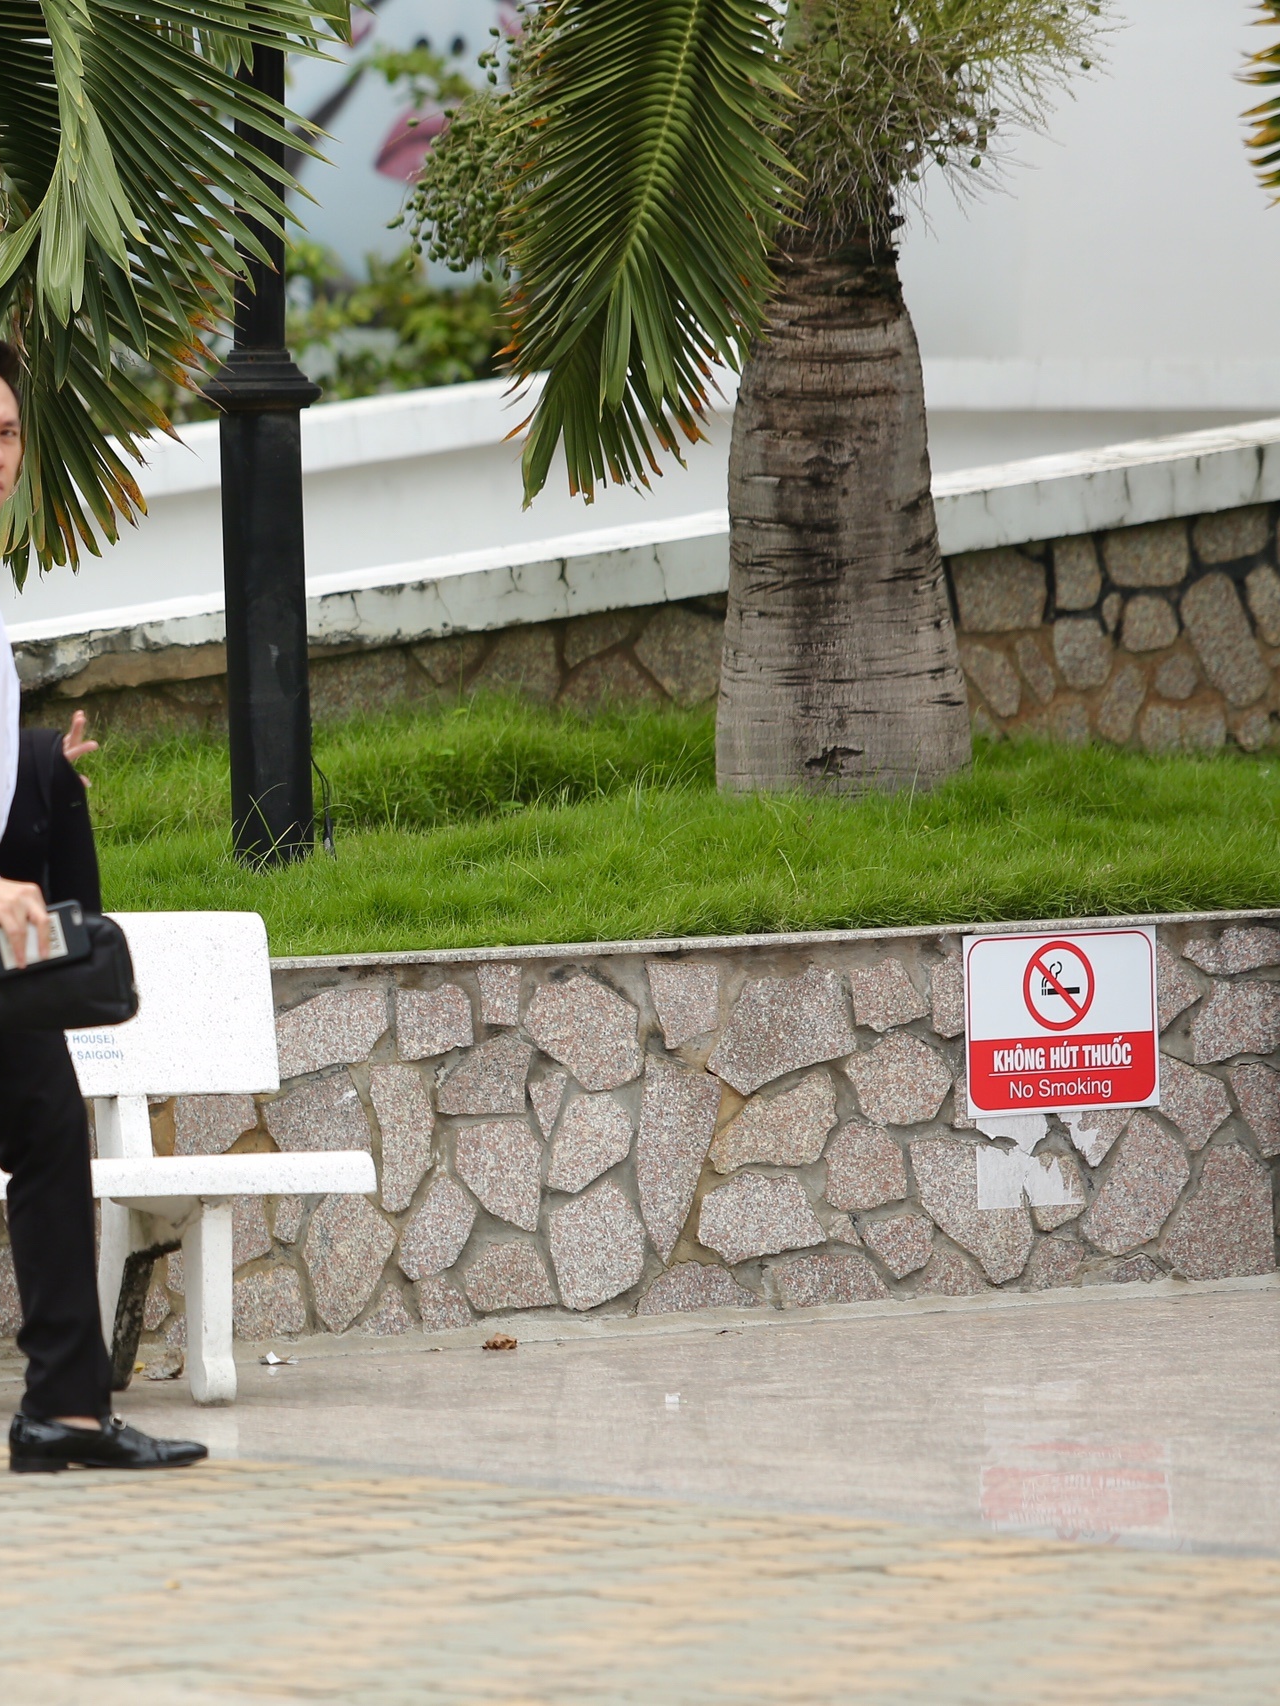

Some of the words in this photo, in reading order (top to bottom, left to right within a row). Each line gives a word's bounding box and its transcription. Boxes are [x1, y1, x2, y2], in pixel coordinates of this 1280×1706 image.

[72, 1034, 115, 1045] HOUSE)
[77, 1049, 124, 1061] SAIGON)
[993, 1043, 1046, 1072] KHÔNG
[1049, 1040, 1080, 1069] HÚT
[1081, 1035, 1132, 1067] THUỐC
[1009, 1080, 1034, 1099] No
[1038, 1076, 1113, 1098] Smoking
